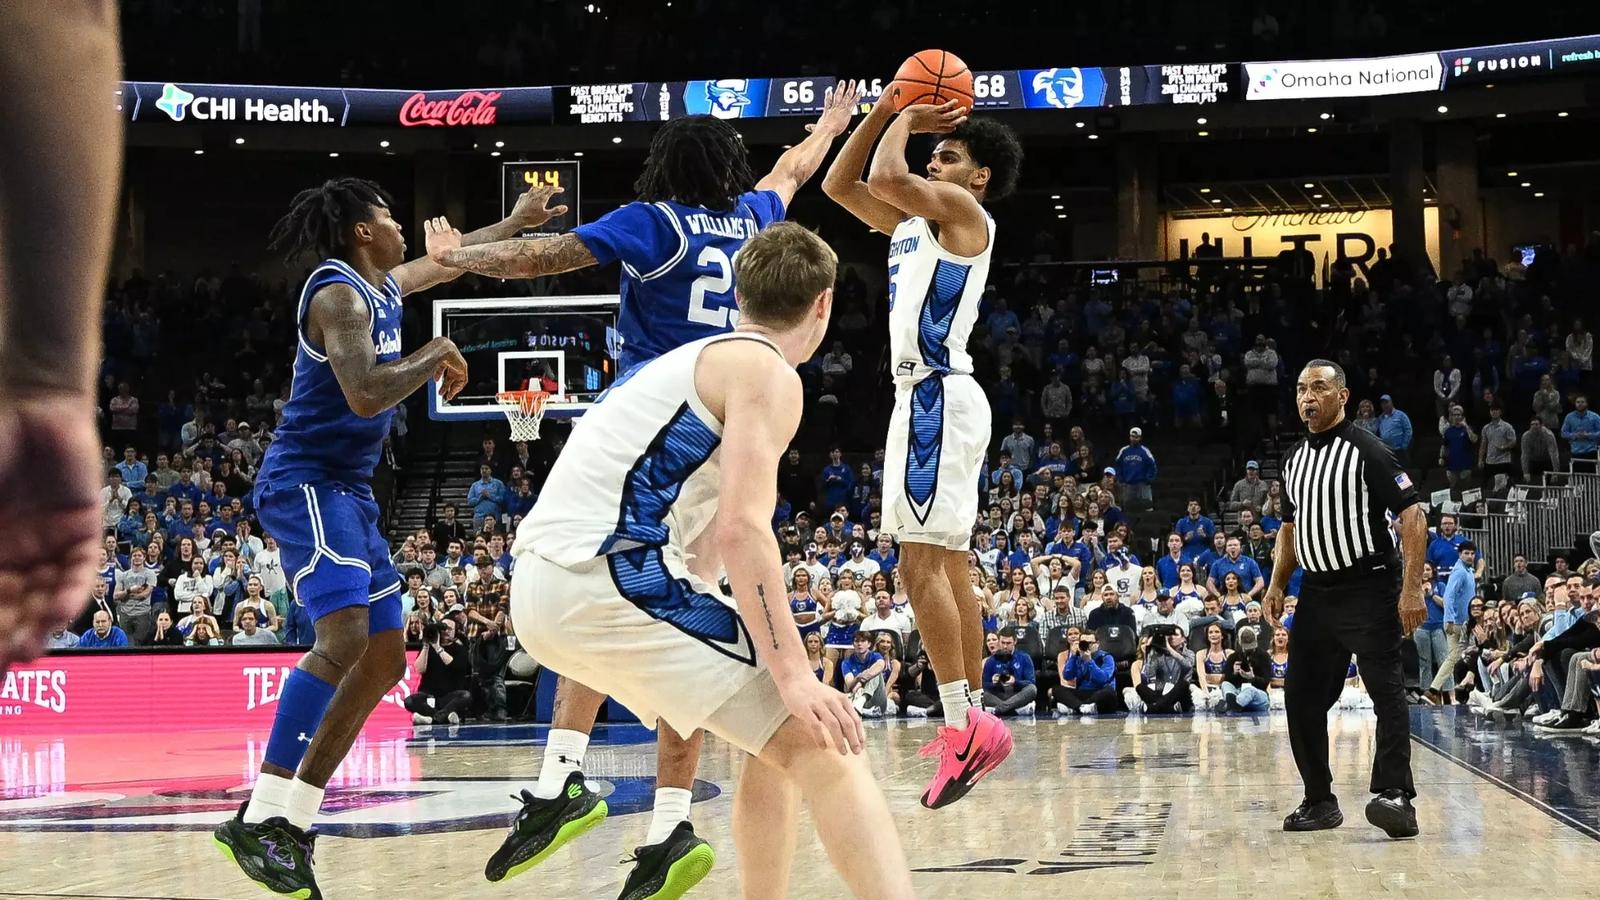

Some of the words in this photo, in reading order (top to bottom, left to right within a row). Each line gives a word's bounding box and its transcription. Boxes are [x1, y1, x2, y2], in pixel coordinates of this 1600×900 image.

[1477, 55, 1541, 72] FUSION
[1561, 51, 1594, 63] refresh
[1162, 65, 1182, 76] FAST
[1182, 65, 1210, 75] BREAK
[1211, 64, 1227, 74] PTS
[1281, 72, 1352, 88] Omaha
[1358, 65, 1435, 85] National
[1168, 75, 1184, 84] PTS
[1185, 74, 1195, 84] IN
[1195, 73, 1220, 83] PAINT
[570, 86, 590, 96] FAST
[590, 85, 617, 96] BREAK
[618, 84, 633, 95] PTS
[783, 81, 814, 103] 66
[974, 74, 1006, 98] 68
[1180, 83, 1211, 94] CHANCE
[1212, 82, 1228, 92] PTS
[577, 95, 592, 105] PTS
[603, 93, 627, 104] PAINT
[1172, 93, 1200, 104] BENCH
[1200, 92, 1217, 103] PTS
[191, 96, 236, 120] CHI
[400, 91, 502, 126] Coca-Cola
[587, 103, 617, 113] CHANCE
[618, 102, 634, 112] PTS
[581, 113, 607, 123] BENCH
[608, 112, 623, 122] PTS
[524, 170, 559, 189] 4.4
[684, 213, 745, 240] WILLIAMS
[687, 245, 740, 329] 2
